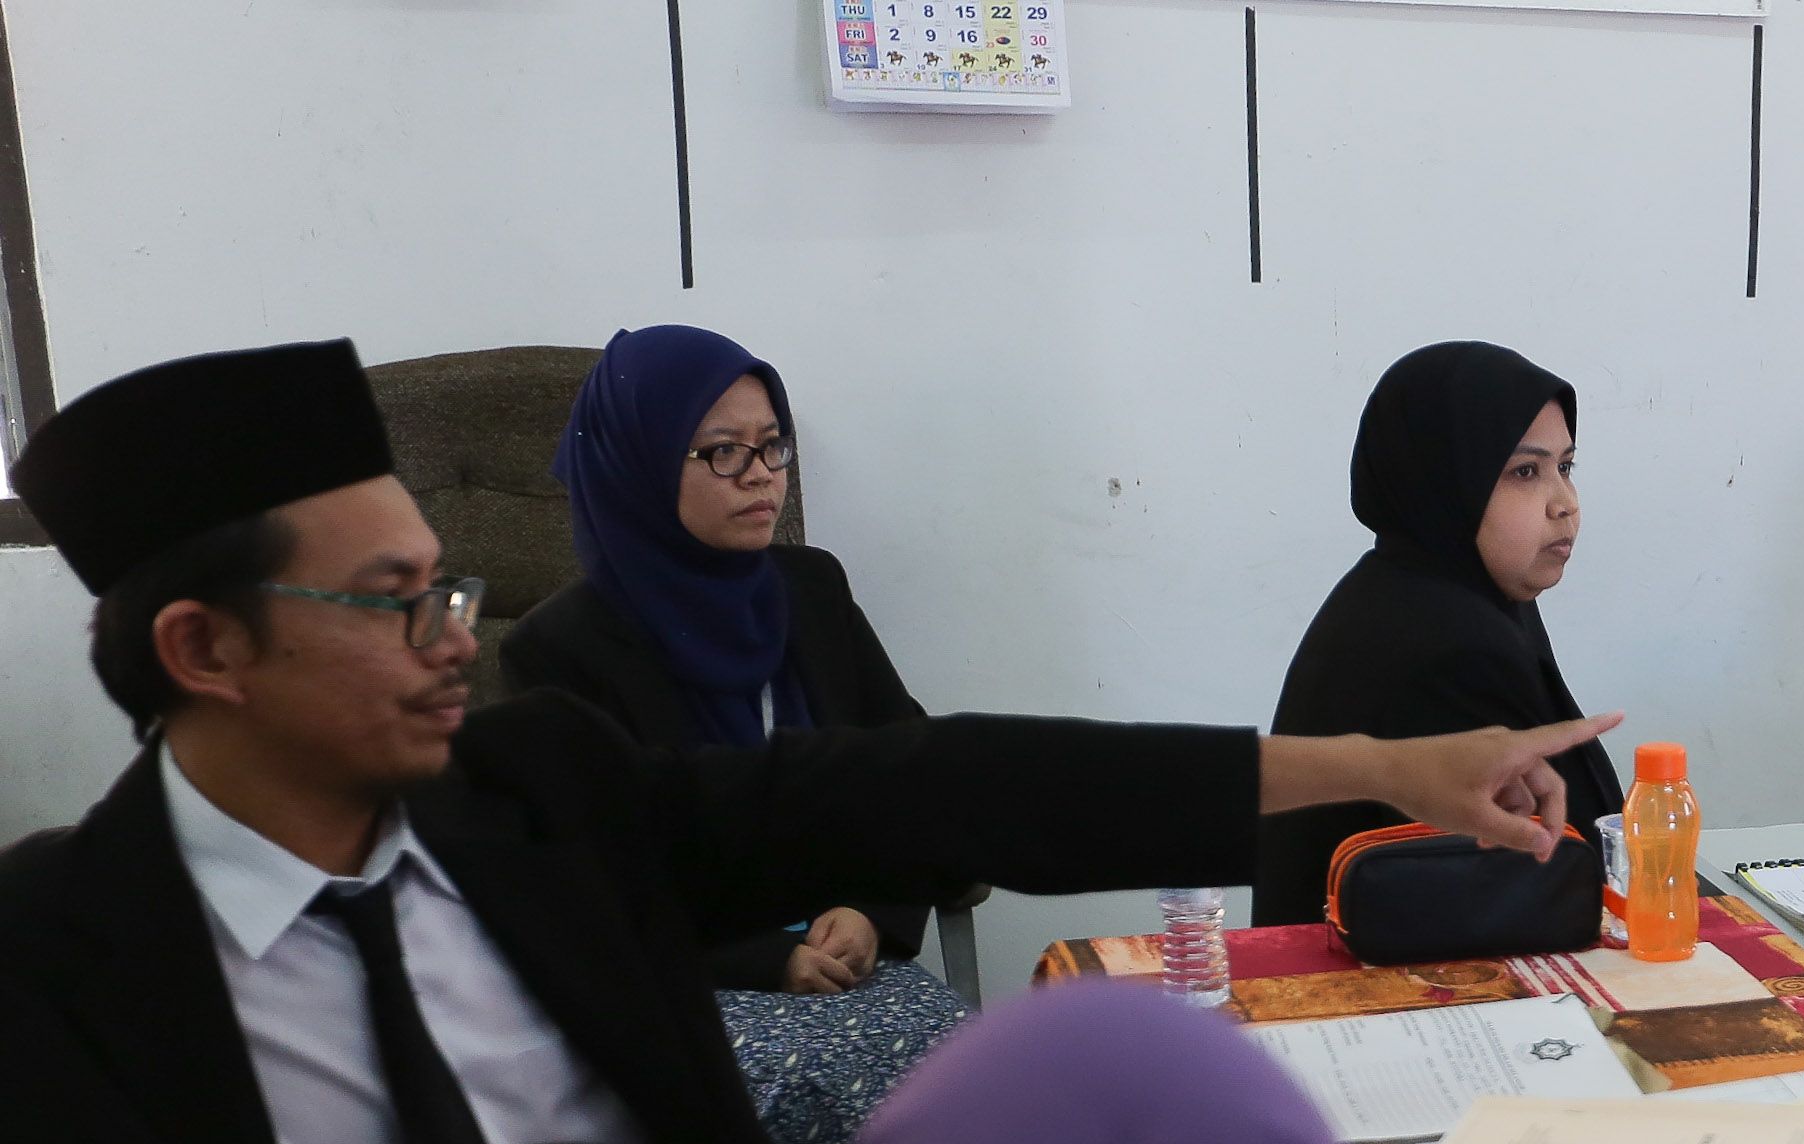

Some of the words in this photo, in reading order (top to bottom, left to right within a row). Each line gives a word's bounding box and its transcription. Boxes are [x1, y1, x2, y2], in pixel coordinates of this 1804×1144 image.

[841, 5, 865, 15] THU
[887, 4, 896, 17] 1
[923, 4, 934, 18] 8
[955, 6, 976, 19] 15
[991, 6, 1012, 19] 22
[1027, 7, 1048, 20] 29
[845, 29, 865, 39] FRI
[889, 28, 901, 41] 2
[925, 29, 936, 42] 9
[957, 30, 978, 43] 16
[1030, 35, 1047, 46] 30
[846, 53, 868, 62] SAT
